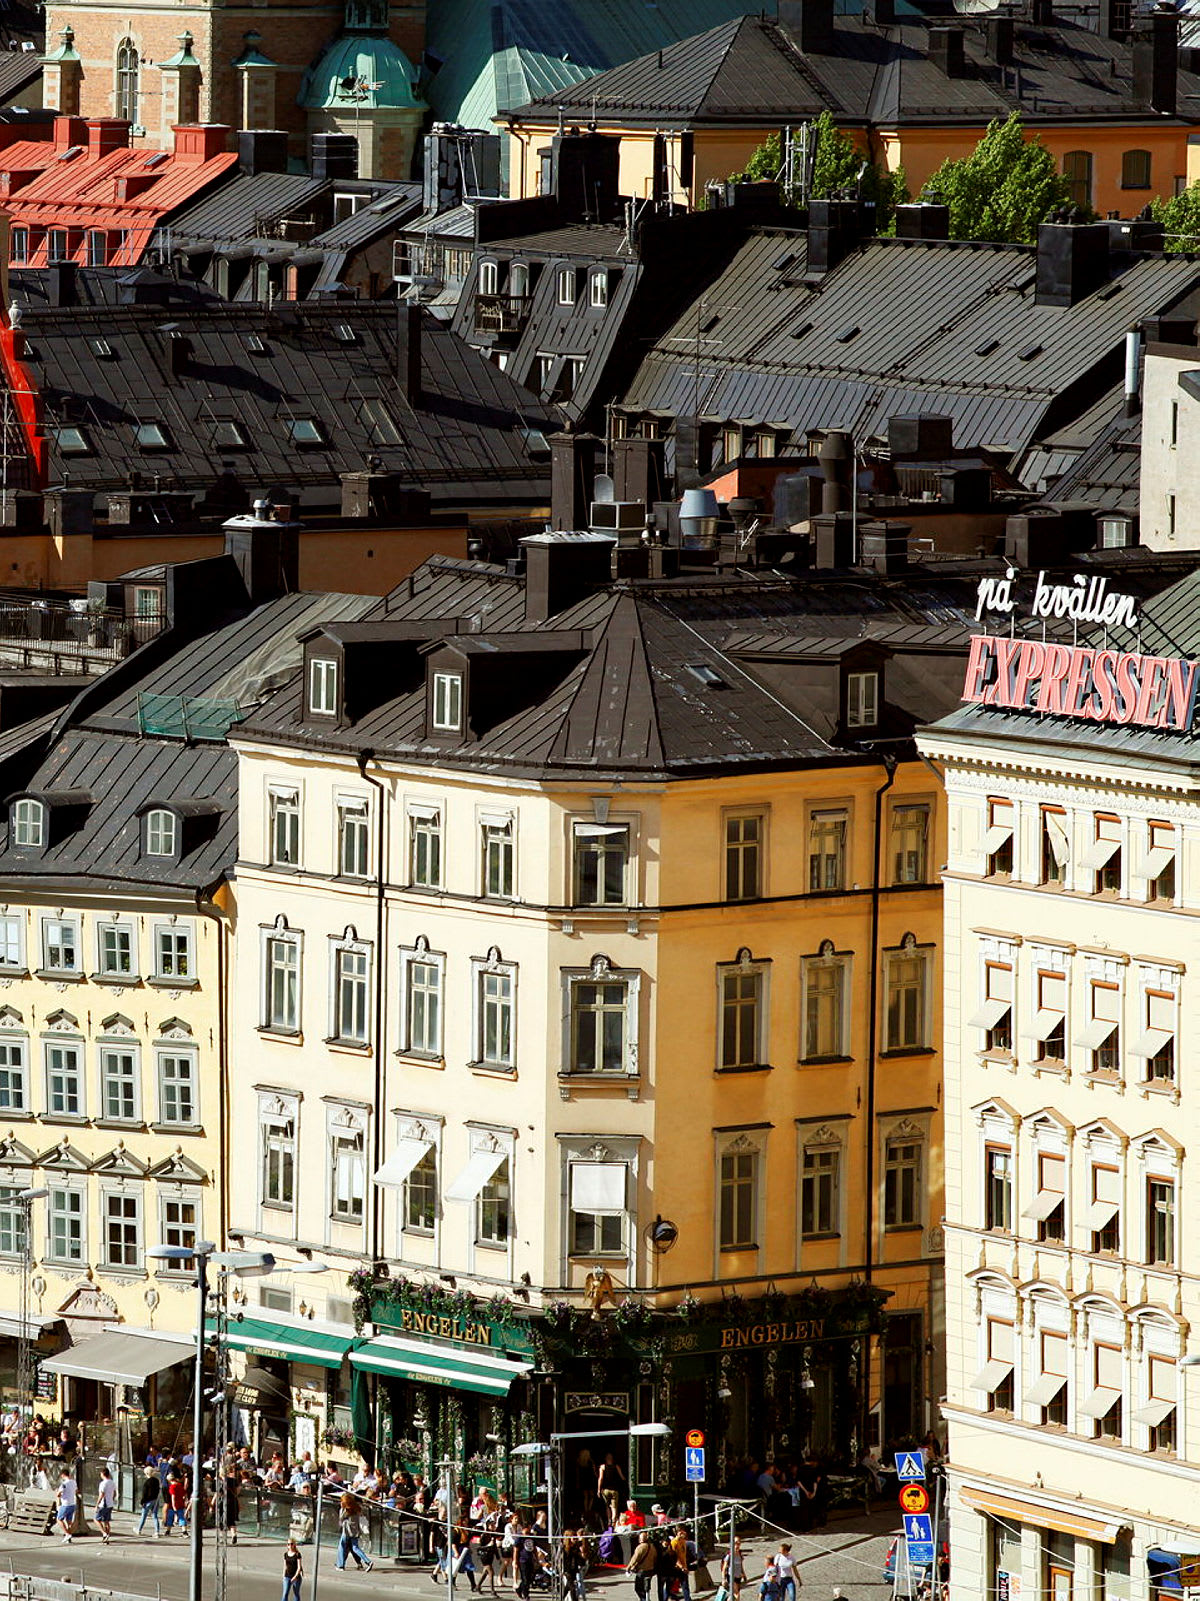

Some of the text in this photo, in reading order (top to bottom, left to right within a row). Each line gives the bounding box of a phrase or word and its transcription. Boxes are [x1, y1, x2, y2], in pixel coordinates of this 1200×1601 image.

[975, 567, 1138, 628] på kvällen
[961, 634, 1199, 731] EXPRESSEN
[400, 1308, 491, 1345] ENGELEN
[720, 1319, 825, 1348] ENGELEN
